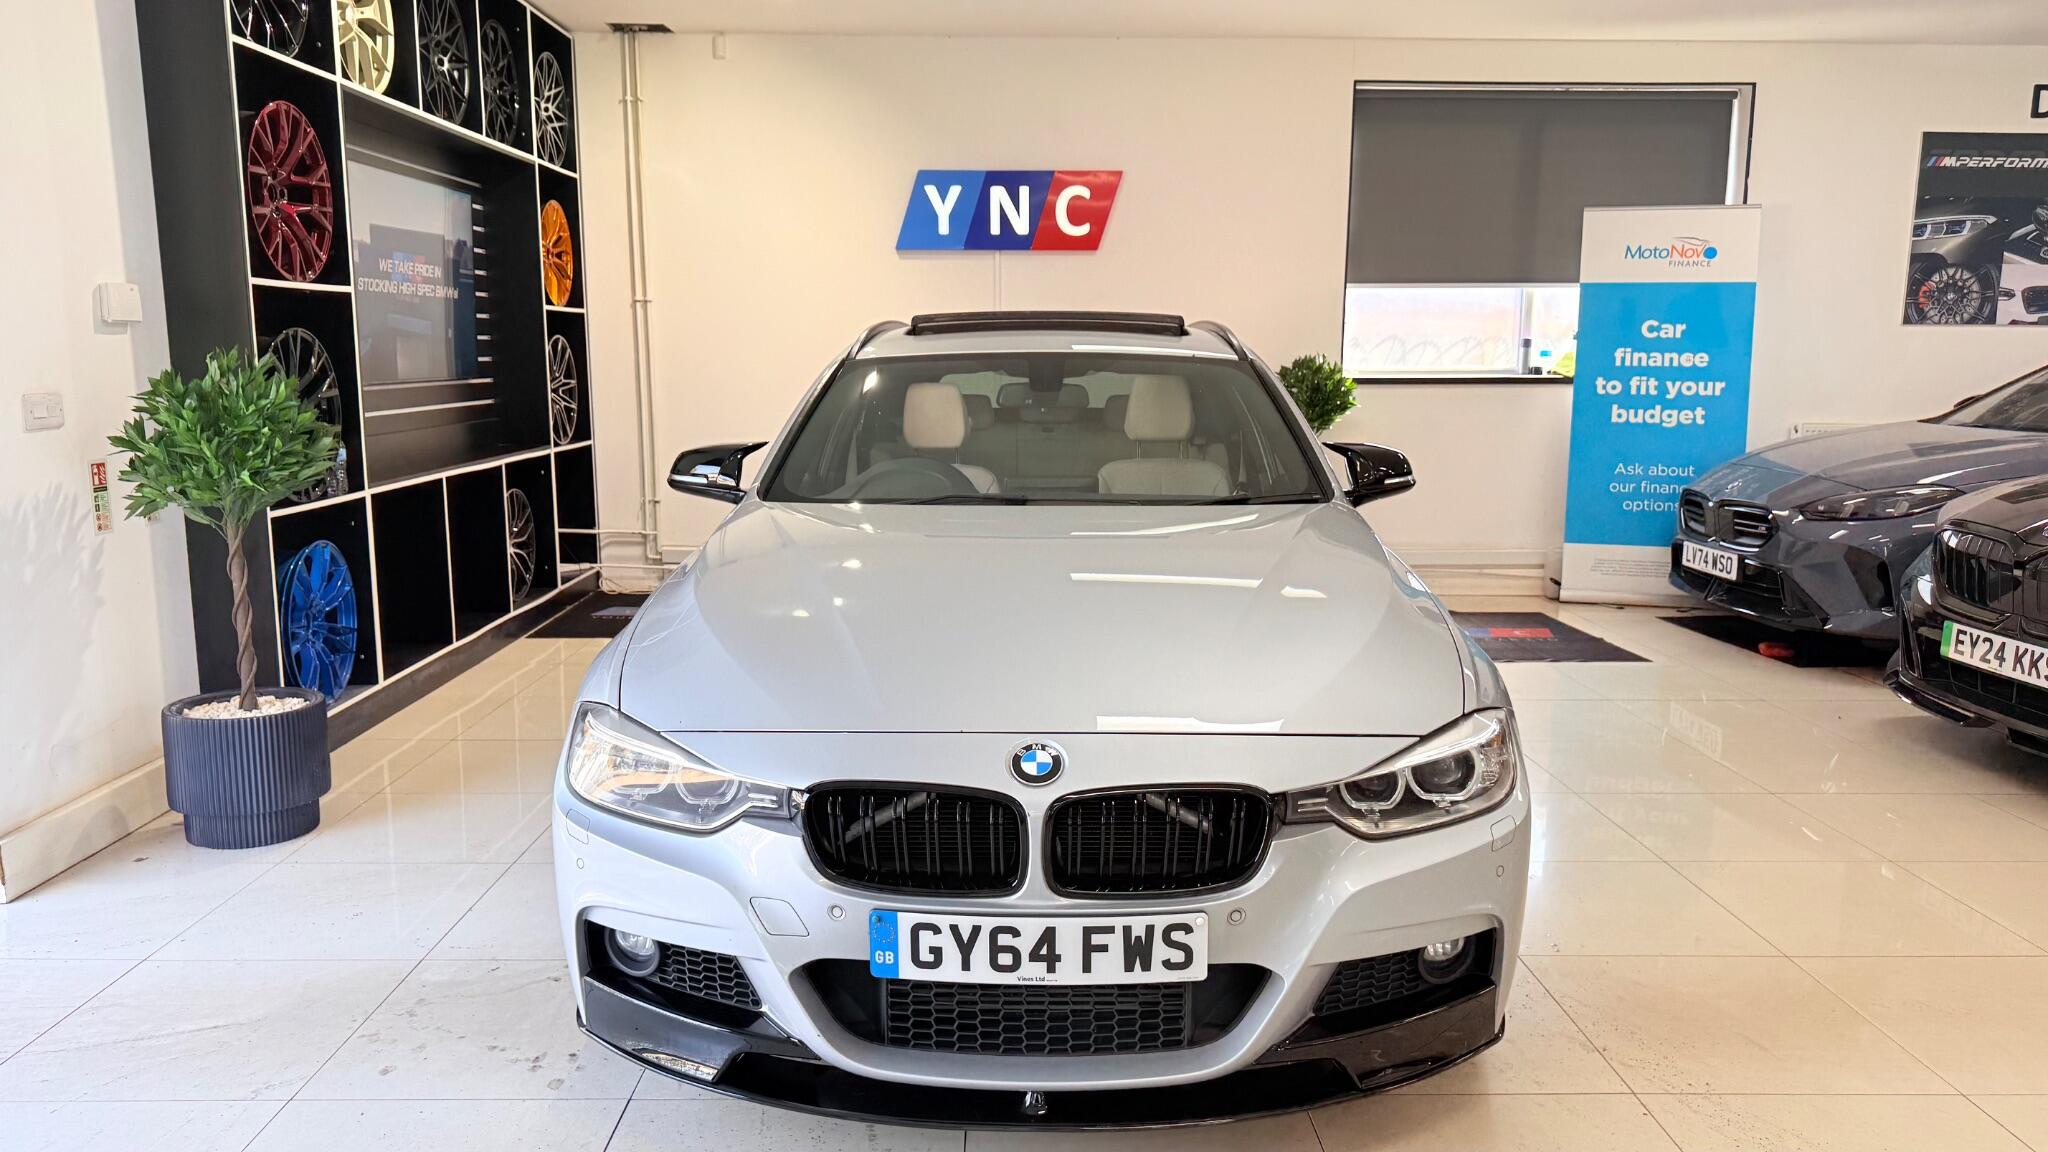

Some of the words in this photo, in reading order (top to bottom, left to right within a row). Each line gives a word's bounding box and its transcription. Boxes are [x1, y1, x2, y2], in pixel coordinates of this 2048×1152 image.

[379, 258, 393, 273] WE
[394, 261, 414, 275] TAKE
[414, 263, 434, 278] PRIDE
[434, 265, 442, 279] IN
[1668, 260, 1712, 268] FINANCE
[357, 277, 398, 294] STOCKING
[398, 281, 417, 296] HIGH
[417, 283, 435, 297] SPEC
[1641, 320, 1686, 338] Car
[1614, 348, 1709, 367] finance
[1596, 377, 1622, 395] to
[1630, 376, 1658, 395] fit
[1665, 380, 1725, 399] your
[1611, 404, 1705, 427] budget
[1614, 463, 1644, 475] Ask
[1648, 464, 1695, 477] about
[1609, 483, 1636, 493] our
[1685, 544, 1709, 568] LV74
[1711, 552, 1733, 575] WSO
[1953, 628, 2006, 668] EY24
[1016, 743, 1060, 756] BMW
[910, 922, 1062, 974] GY64
[1082, 922, 1195, 974] FWS
[875, 951, 894, 965] GB
